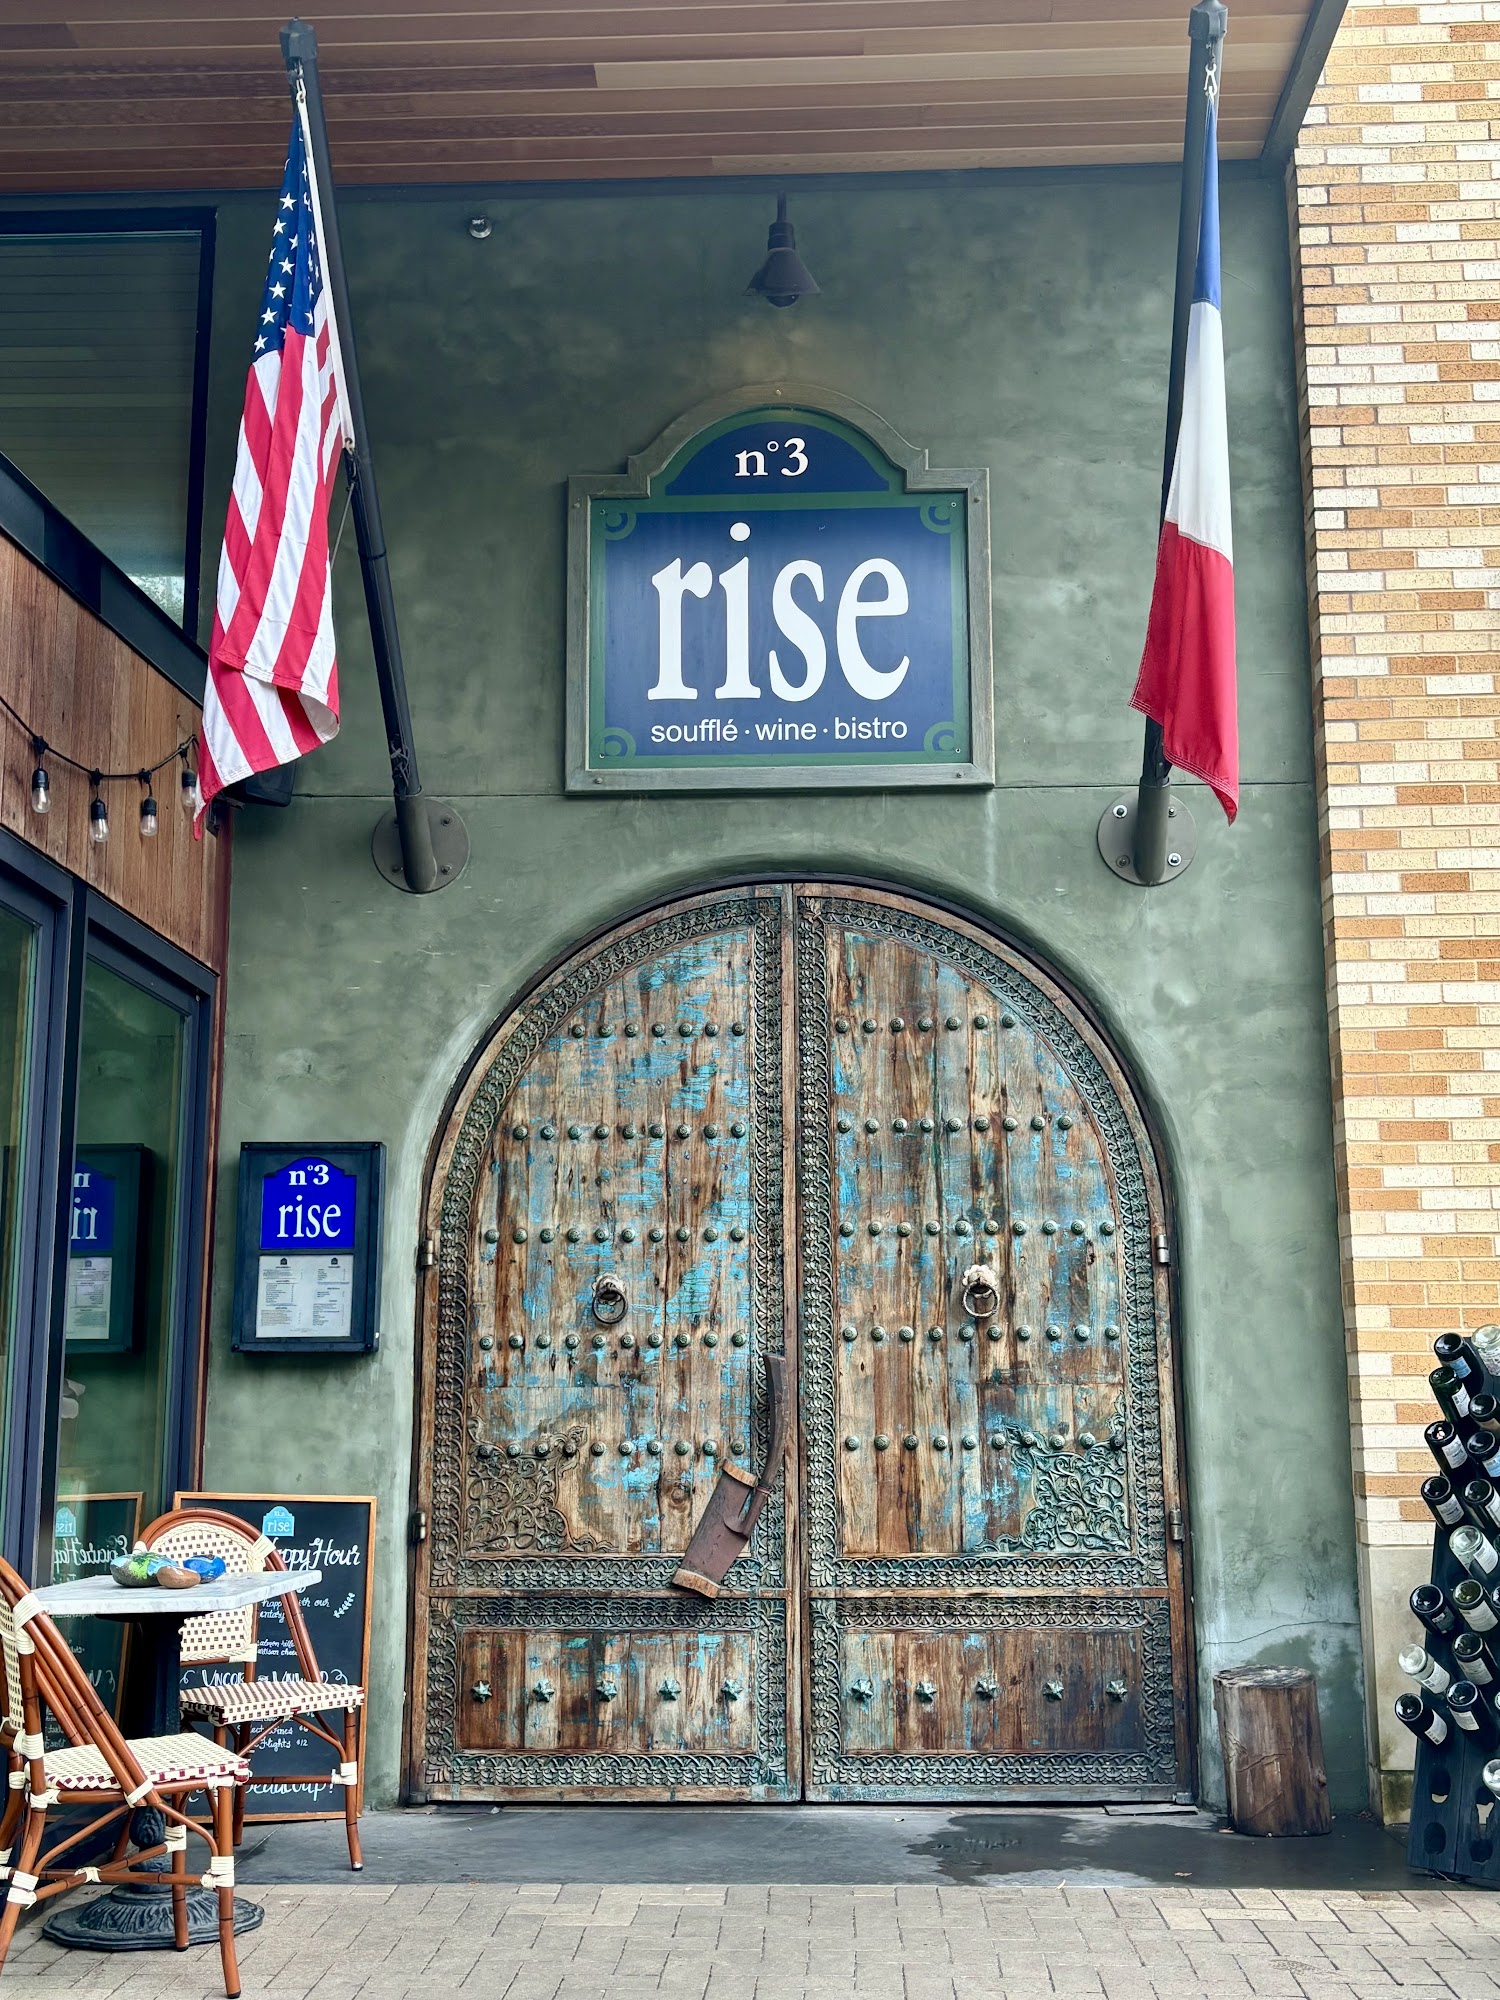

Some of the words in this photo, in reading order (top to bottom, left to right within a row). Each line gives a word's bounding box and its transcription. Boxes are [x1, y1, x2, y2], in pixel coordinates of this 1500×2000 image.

[647, 522, 910, 702] rise
[651, 718, 738, 743] soufflé
[754, 718, 817, 741] wine
[834, 716, 908, 740] bistro
[276, 1194, 342, 1238] rise
[267, 1520, 291, 1532] rise
[309, 1537, 361, 1569] Hour
[313, 1598, 330, 1608] our
